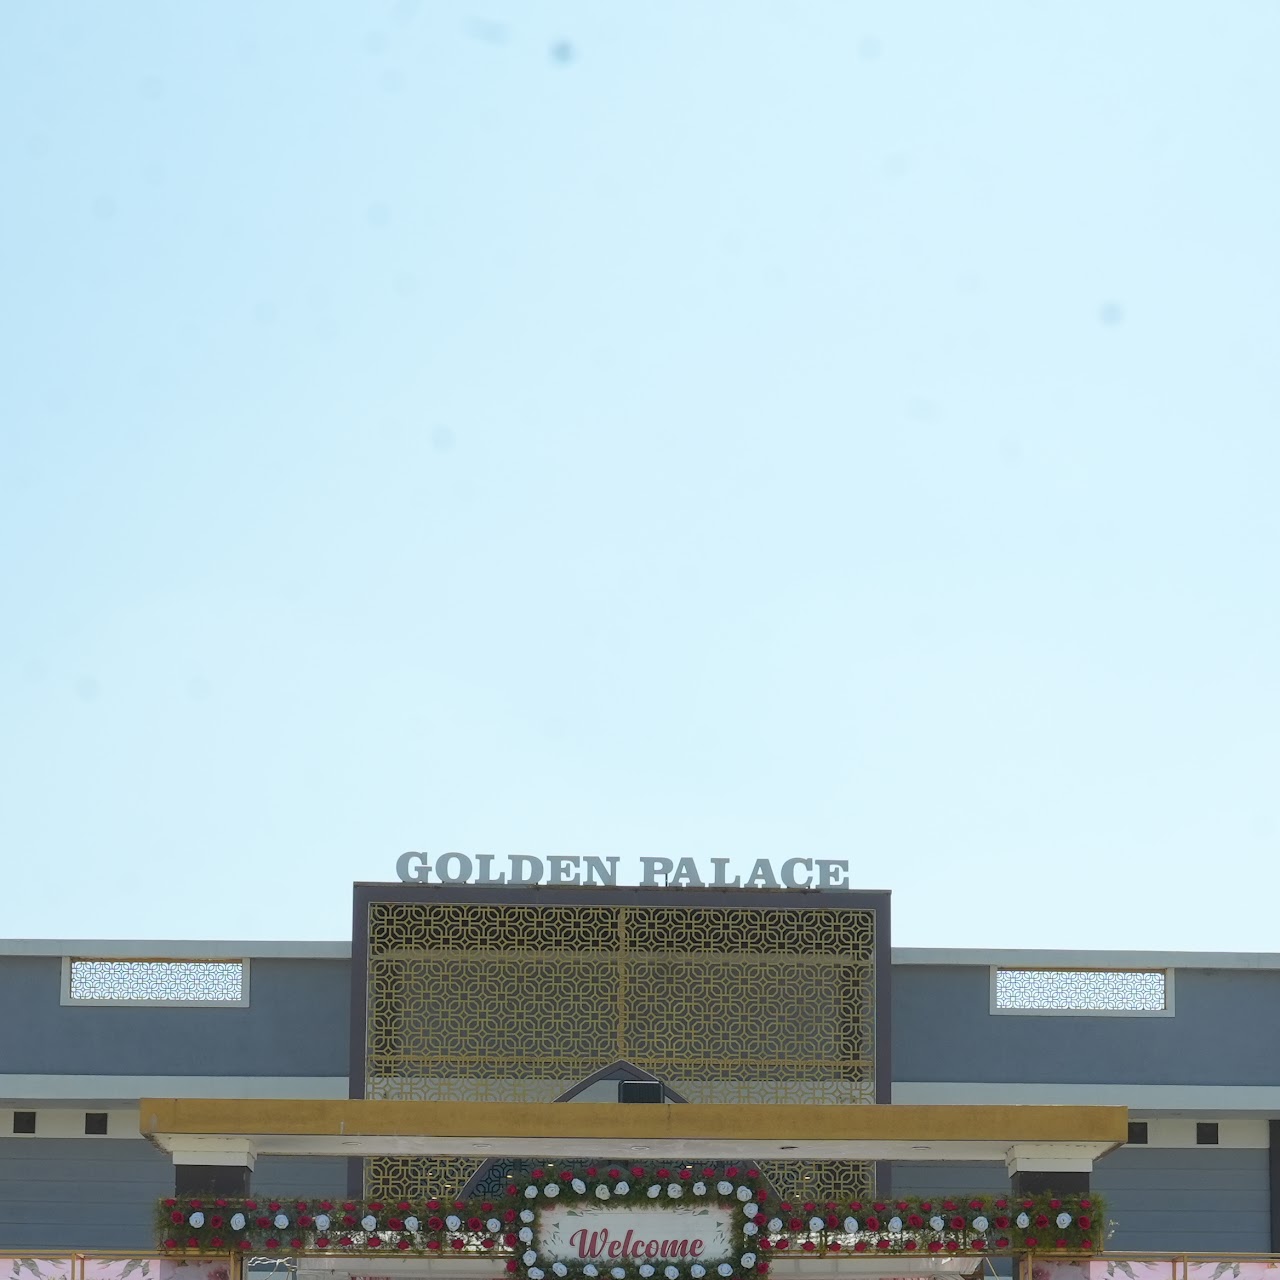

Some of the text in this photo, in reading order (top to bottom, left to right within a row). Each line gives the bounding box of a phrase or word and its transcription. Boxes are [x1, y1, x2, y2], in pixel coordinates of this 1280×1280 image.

[396, 851, 849, 889] GOLDEN PALACE
[569, 1227, 706, 1259] Welcome
